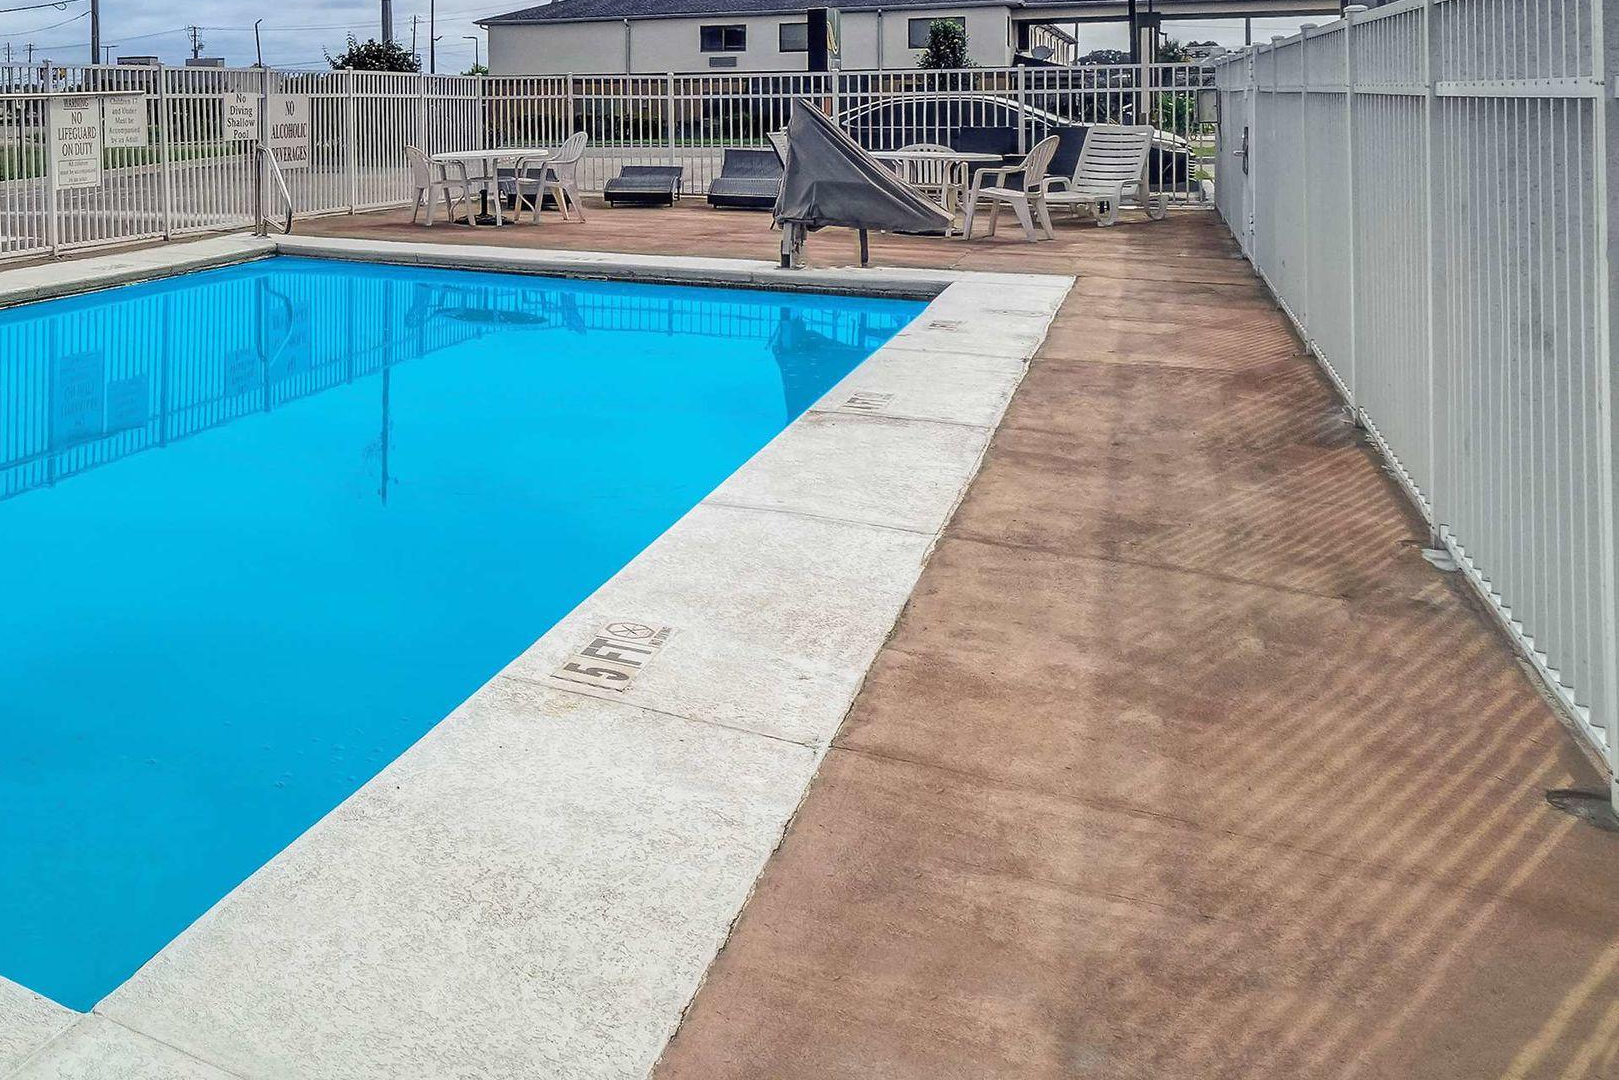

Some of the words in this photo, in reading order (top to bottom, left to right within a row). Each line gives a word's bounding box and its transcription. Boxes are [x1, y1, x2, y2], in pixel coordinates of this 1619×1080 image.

[236, 93, 247, 103] No
[230, 105, 253, 117] Diving
[285, 100, 295, 116] NO
[71, 112, 83, 125] NO
[227, 117, 255, 128] Shallow
[58, 127, 97, 141] LIFEGUARD
[233, 129, 249, 139] Pool
[271, 123, 307, 139] ALCOHOLIC
[62, 144, 73, 157] ON
[75, 143, 93, 155] DUTY
[581, 637, 652, 666] FT
[563, 662, 631, 681] 5
